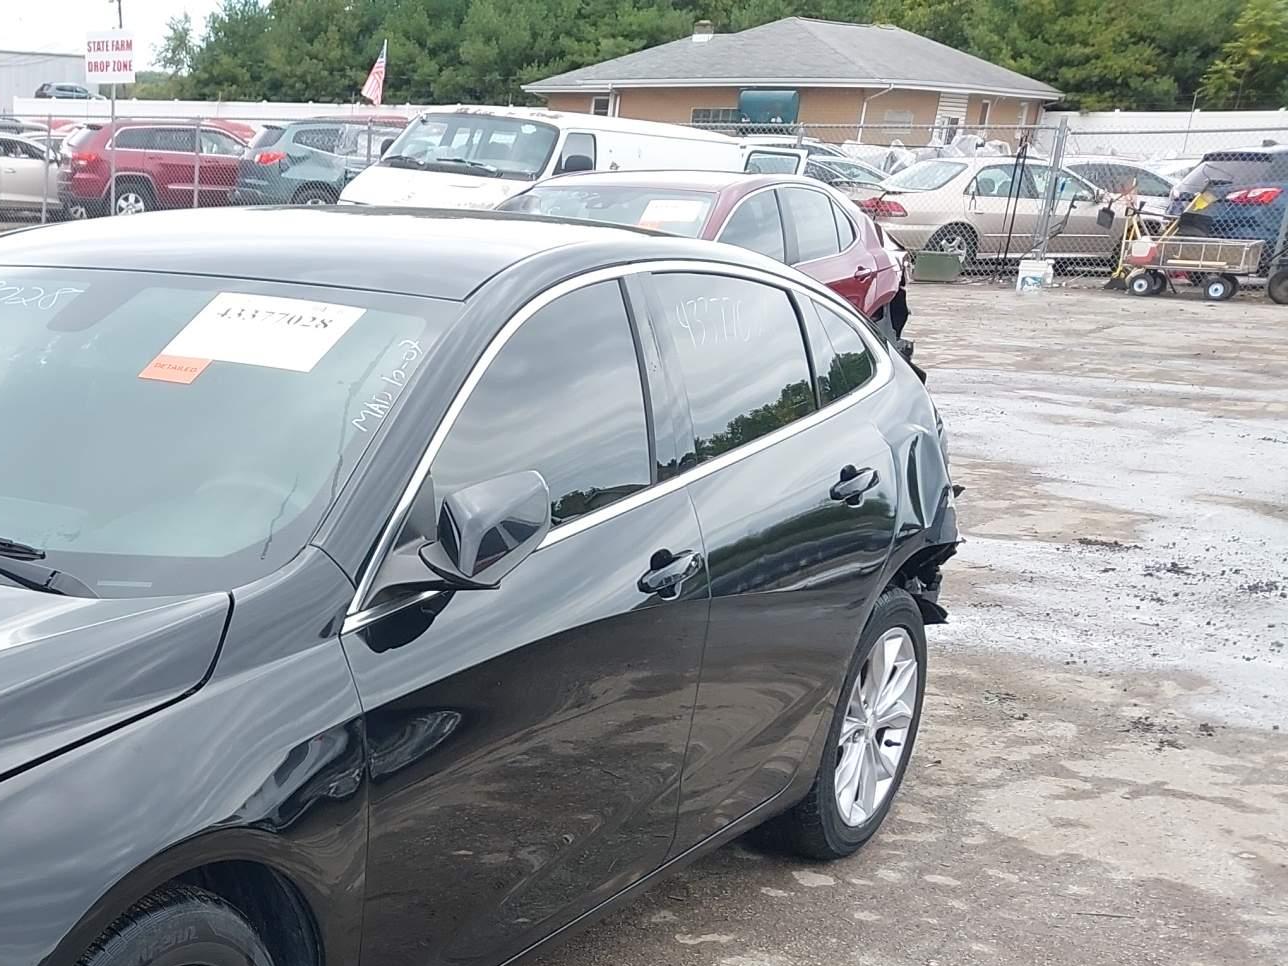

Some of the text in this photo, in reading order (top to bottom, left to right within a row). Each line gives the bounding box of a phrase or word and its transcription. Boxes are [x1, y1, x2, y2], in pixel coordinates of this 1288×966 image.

[87, 39, 133, 52] STATE FARM
[87, 60, 133, 73] DROP ZONE
[216, 307, 334, 329] 43377028
[153, 361, 199, 374] DETAILED
